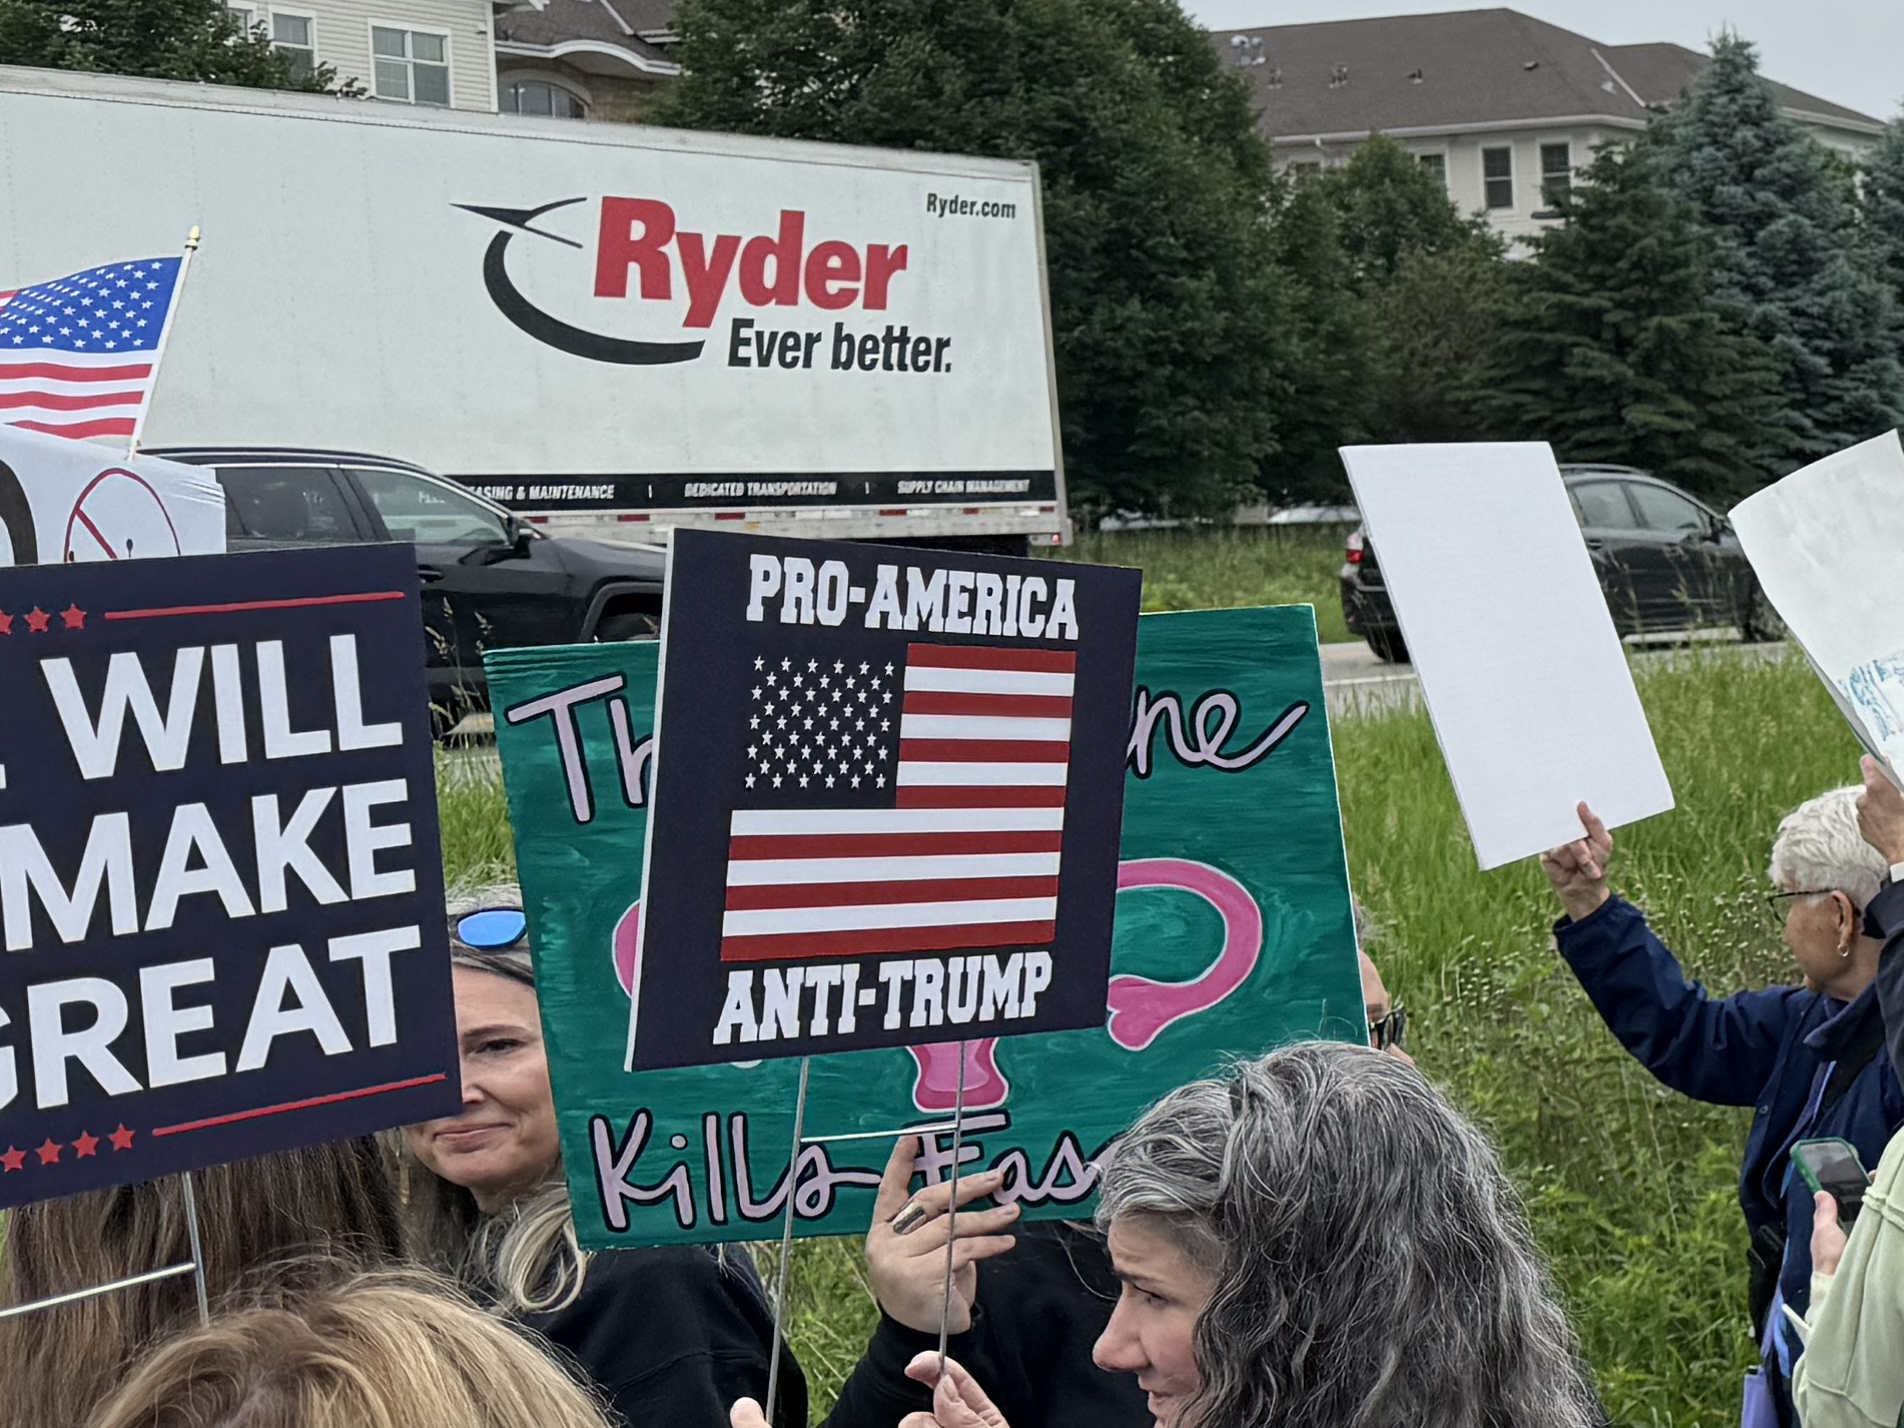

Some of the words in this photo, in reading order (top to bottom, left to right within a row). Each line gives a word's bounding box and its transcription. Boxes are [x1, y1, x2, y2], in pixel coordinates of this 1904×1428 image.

[927, 192, 1016, 220] Ryder.com
[593, 195, 909, 329] Ryder
[727, 317, 822, 369] Ever
[830, 321, 952, 373] better.
[516, 485, 526, 500] &
[529, 484, 615, 501] MAINTENANCE
[685, 482, 745, 498] DEDICATED
[746, 553, 1079, 640] PRO-AMERICA
[40, 634, 403, 780] WILL
[0, 778, 417, 952] MAKE
[0, 924, 421, 1111] REAT
[712, 951, 1053, 1045] ANTI-TRUMP
[903, 1110, 1106, 1206] Fas
